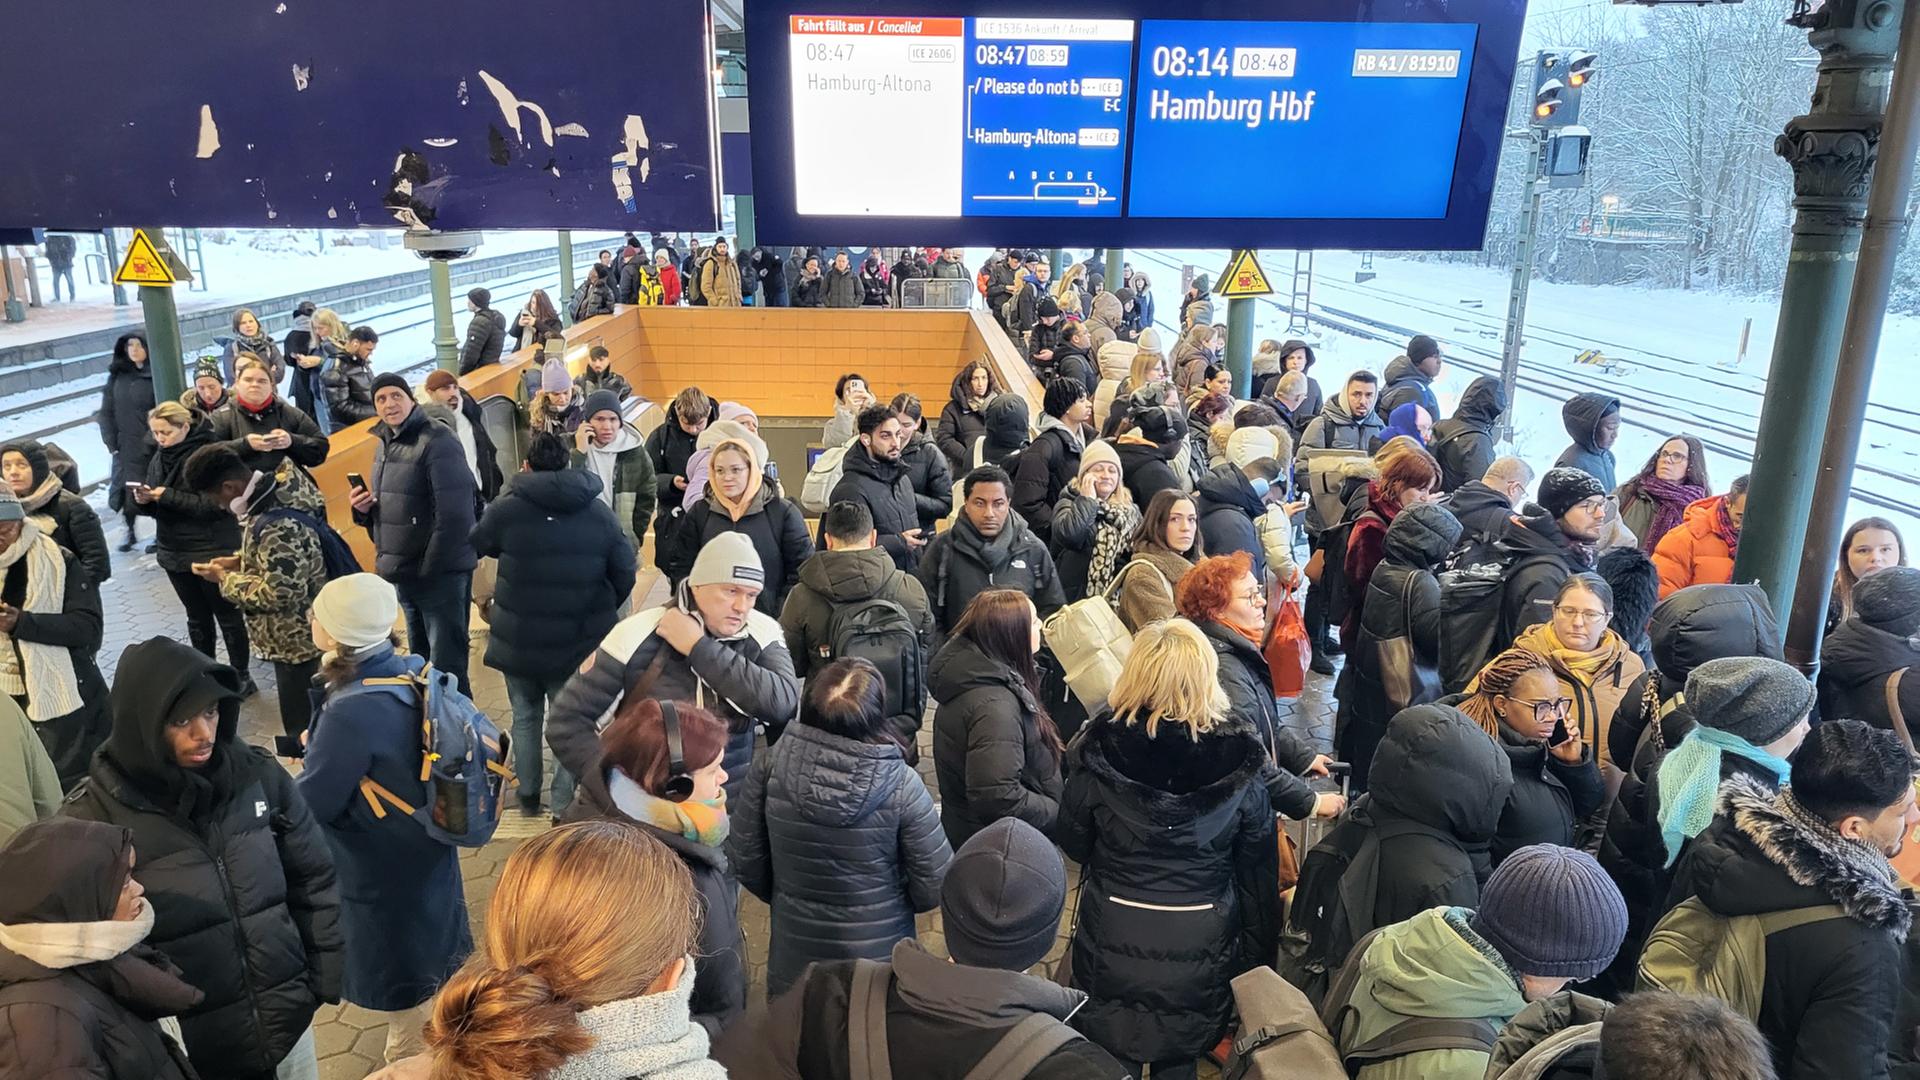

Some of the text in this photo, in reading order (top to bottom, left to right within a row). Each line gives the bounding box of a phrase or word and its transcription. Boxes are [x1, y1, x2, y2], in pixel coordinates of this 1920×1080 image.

[798, 19, 825, 32] Fahrt
[825, 19, 847, 33] fällt
[848, 22, 865, 33] aus
[877, 21, 923, 33] Cancelled
[980, 22, 995, 31] ICE
[998, 22, 1022, 31] 1536
[1024, 23, 1060, 33] Ankunft
[1069, 24, 1098, 34] Arrival
[806, 43, 854, 61] 08:47
[912, 48, 952, 59] ICE 2606
[975, 45, 1066, 65] 08:47 08:59
[1152, 46, 1289, 77] 08:14 08:48
[1357, 55, 1376, 71] RB
[1378, 55, 1397, 71] 41
[1408, 55, 1456, 72] 81910
[808, 73, 932, 95] Hamburg-Altona
[984, 77, 1025, 95] Please
[1028, 78, 1044, 95] do
[1046, 79, 1068, 95] not
[1070, 78, 1080, 95] b
[1098, 83, 1112, 93] ICE
[1104, 98, 1121, 112] E-C
[1151, 89, 1316, 128] Hamburg Hbf
[975, 128, 1077, 147] Hamburg-Altona
[1096, 133, 1117, 142] ICE 2
[1008, 171, 1093, 180] A B C D E
